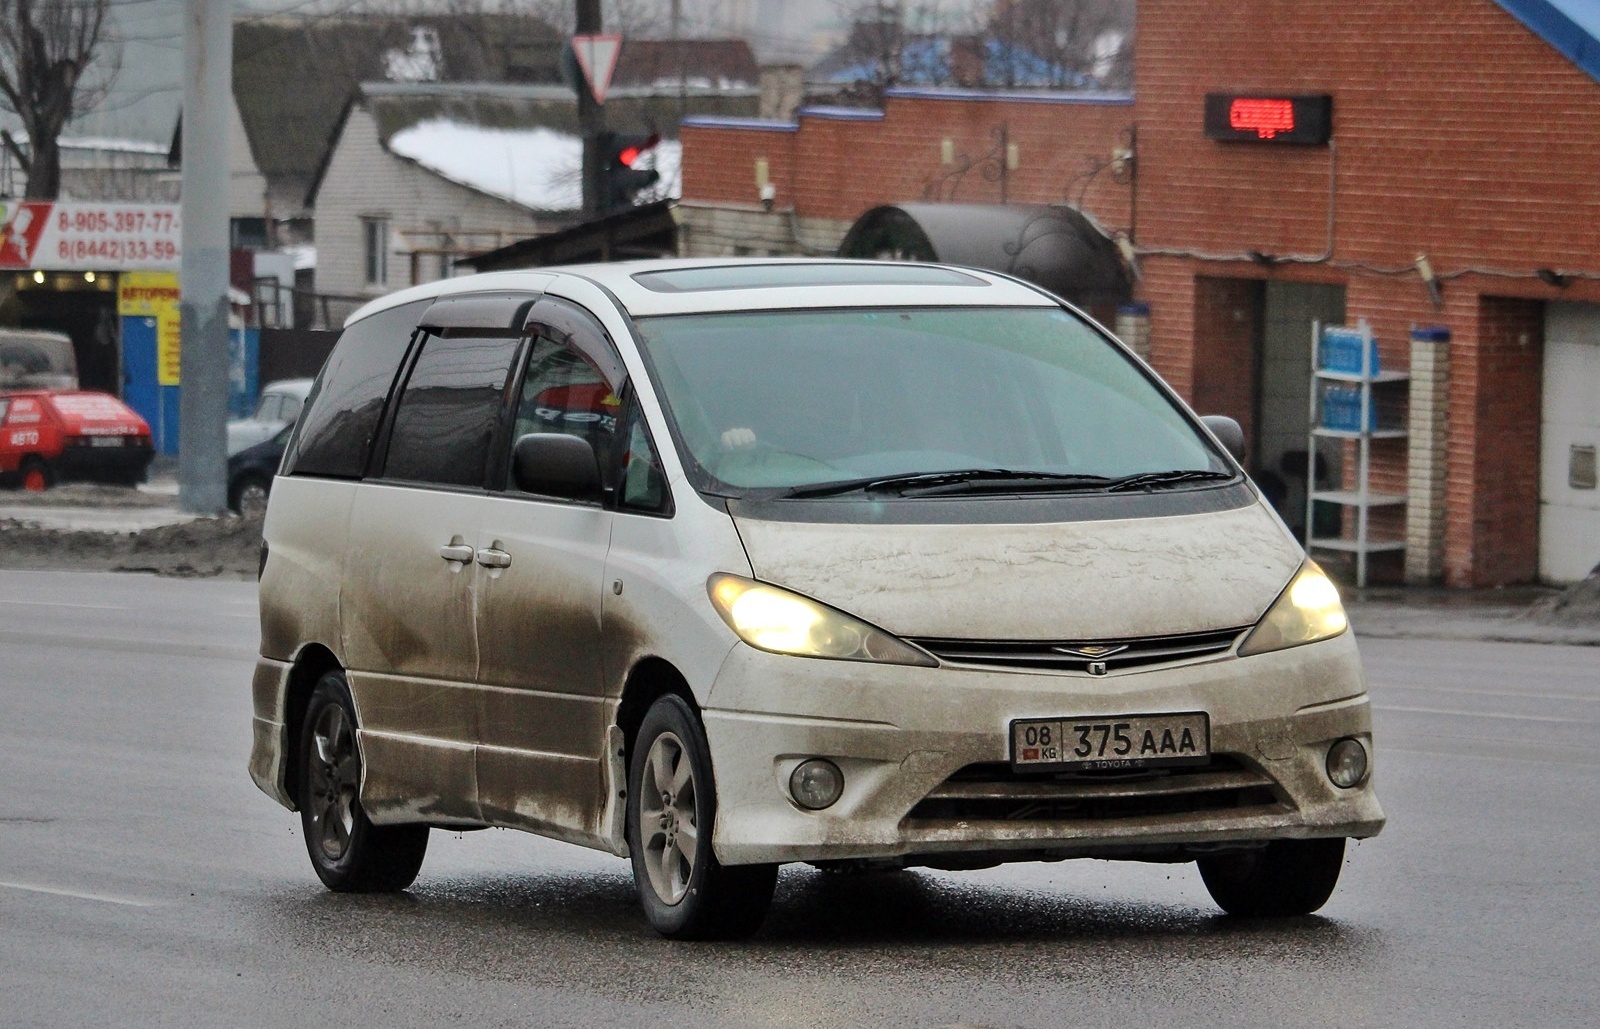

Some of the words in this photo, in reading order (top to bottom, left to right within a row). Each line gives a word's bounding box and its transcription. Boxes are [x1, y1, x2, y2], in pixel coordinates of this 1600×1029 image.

[59, 211, 179, 232] 8-905-397-77-
[1025, 726, 1052, 746] 08
[1073, 723, 1132, 757] 375
[1140, 727, 1196, 755] AAA
[1041, 747, 1057, 759] KG
